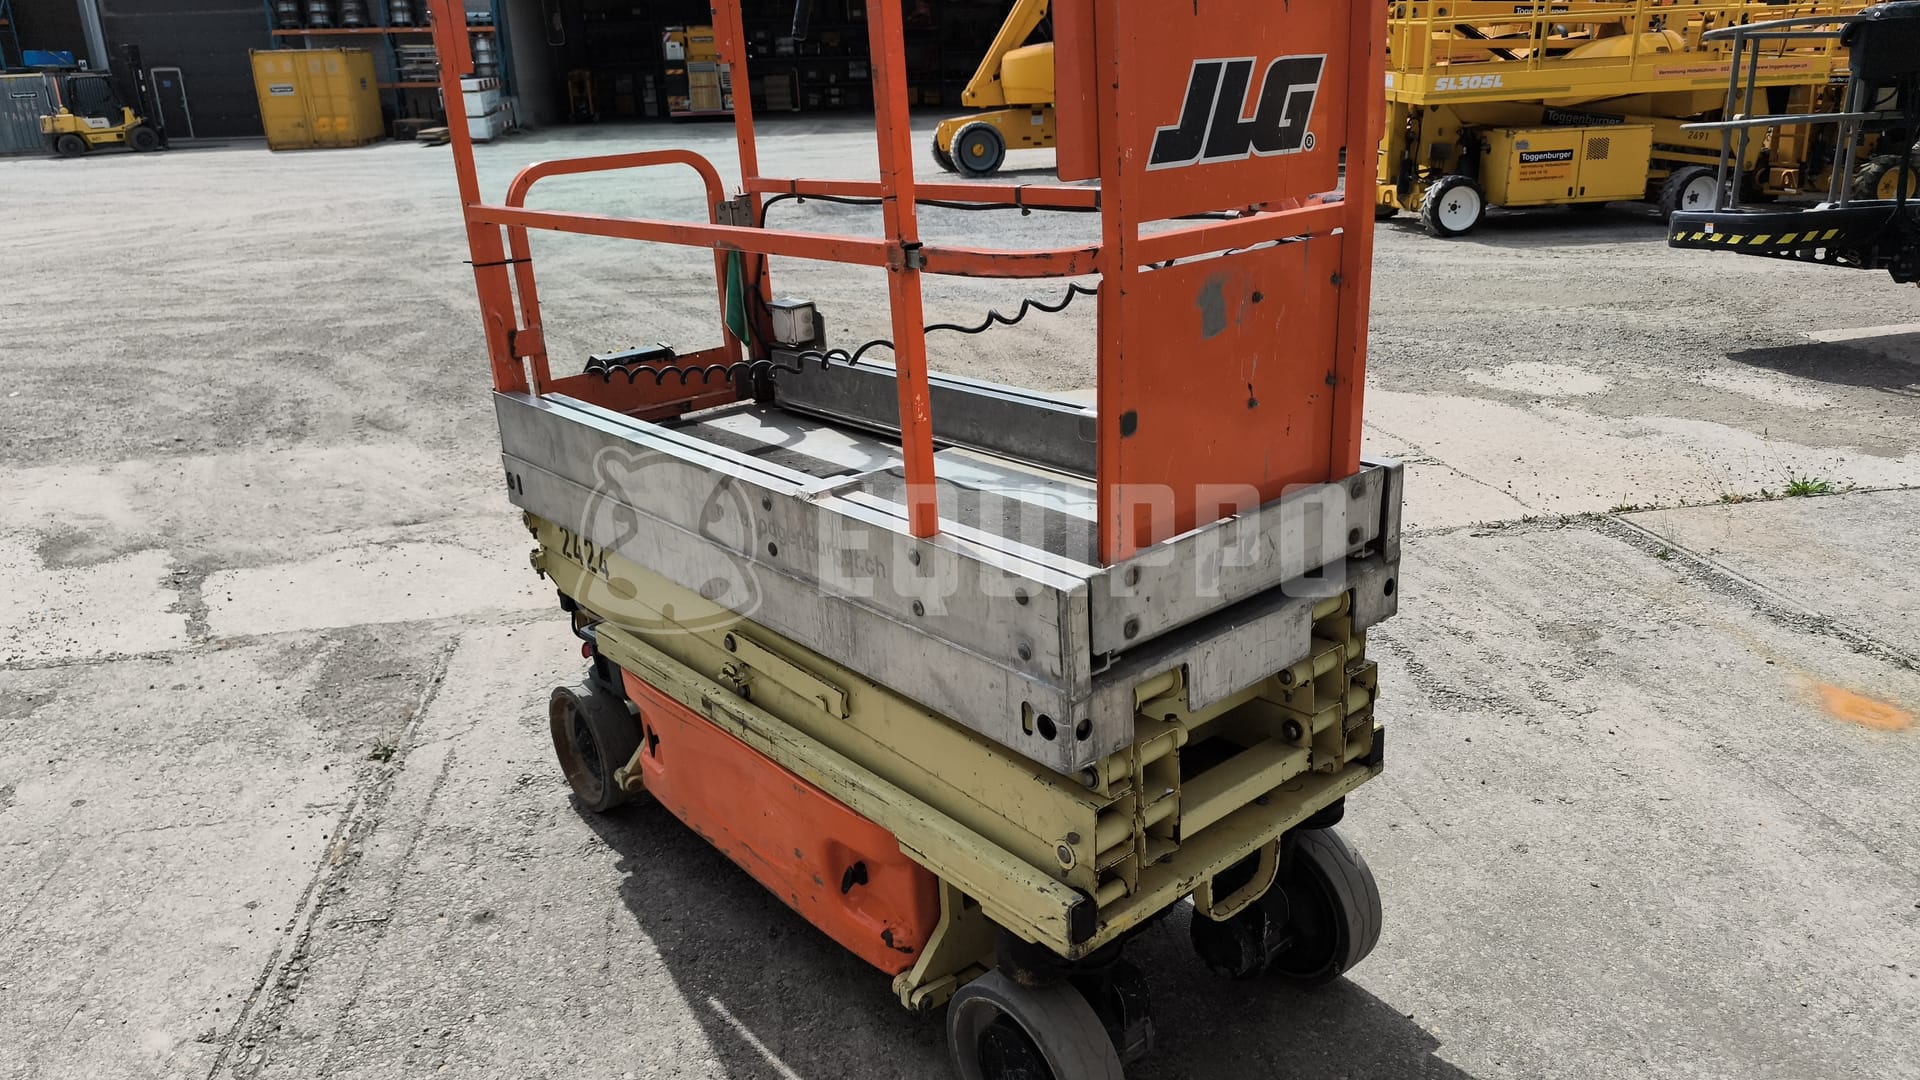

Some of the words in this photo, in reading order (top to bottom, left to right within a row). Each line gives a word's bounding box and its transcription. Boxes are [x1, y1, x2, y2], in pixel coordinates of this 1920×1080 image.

[1435, 75, 1503, 91] SL30SL
[1521, 151, 1572, 162] Toggenburger
[559, 526, 610, 581] 2424
